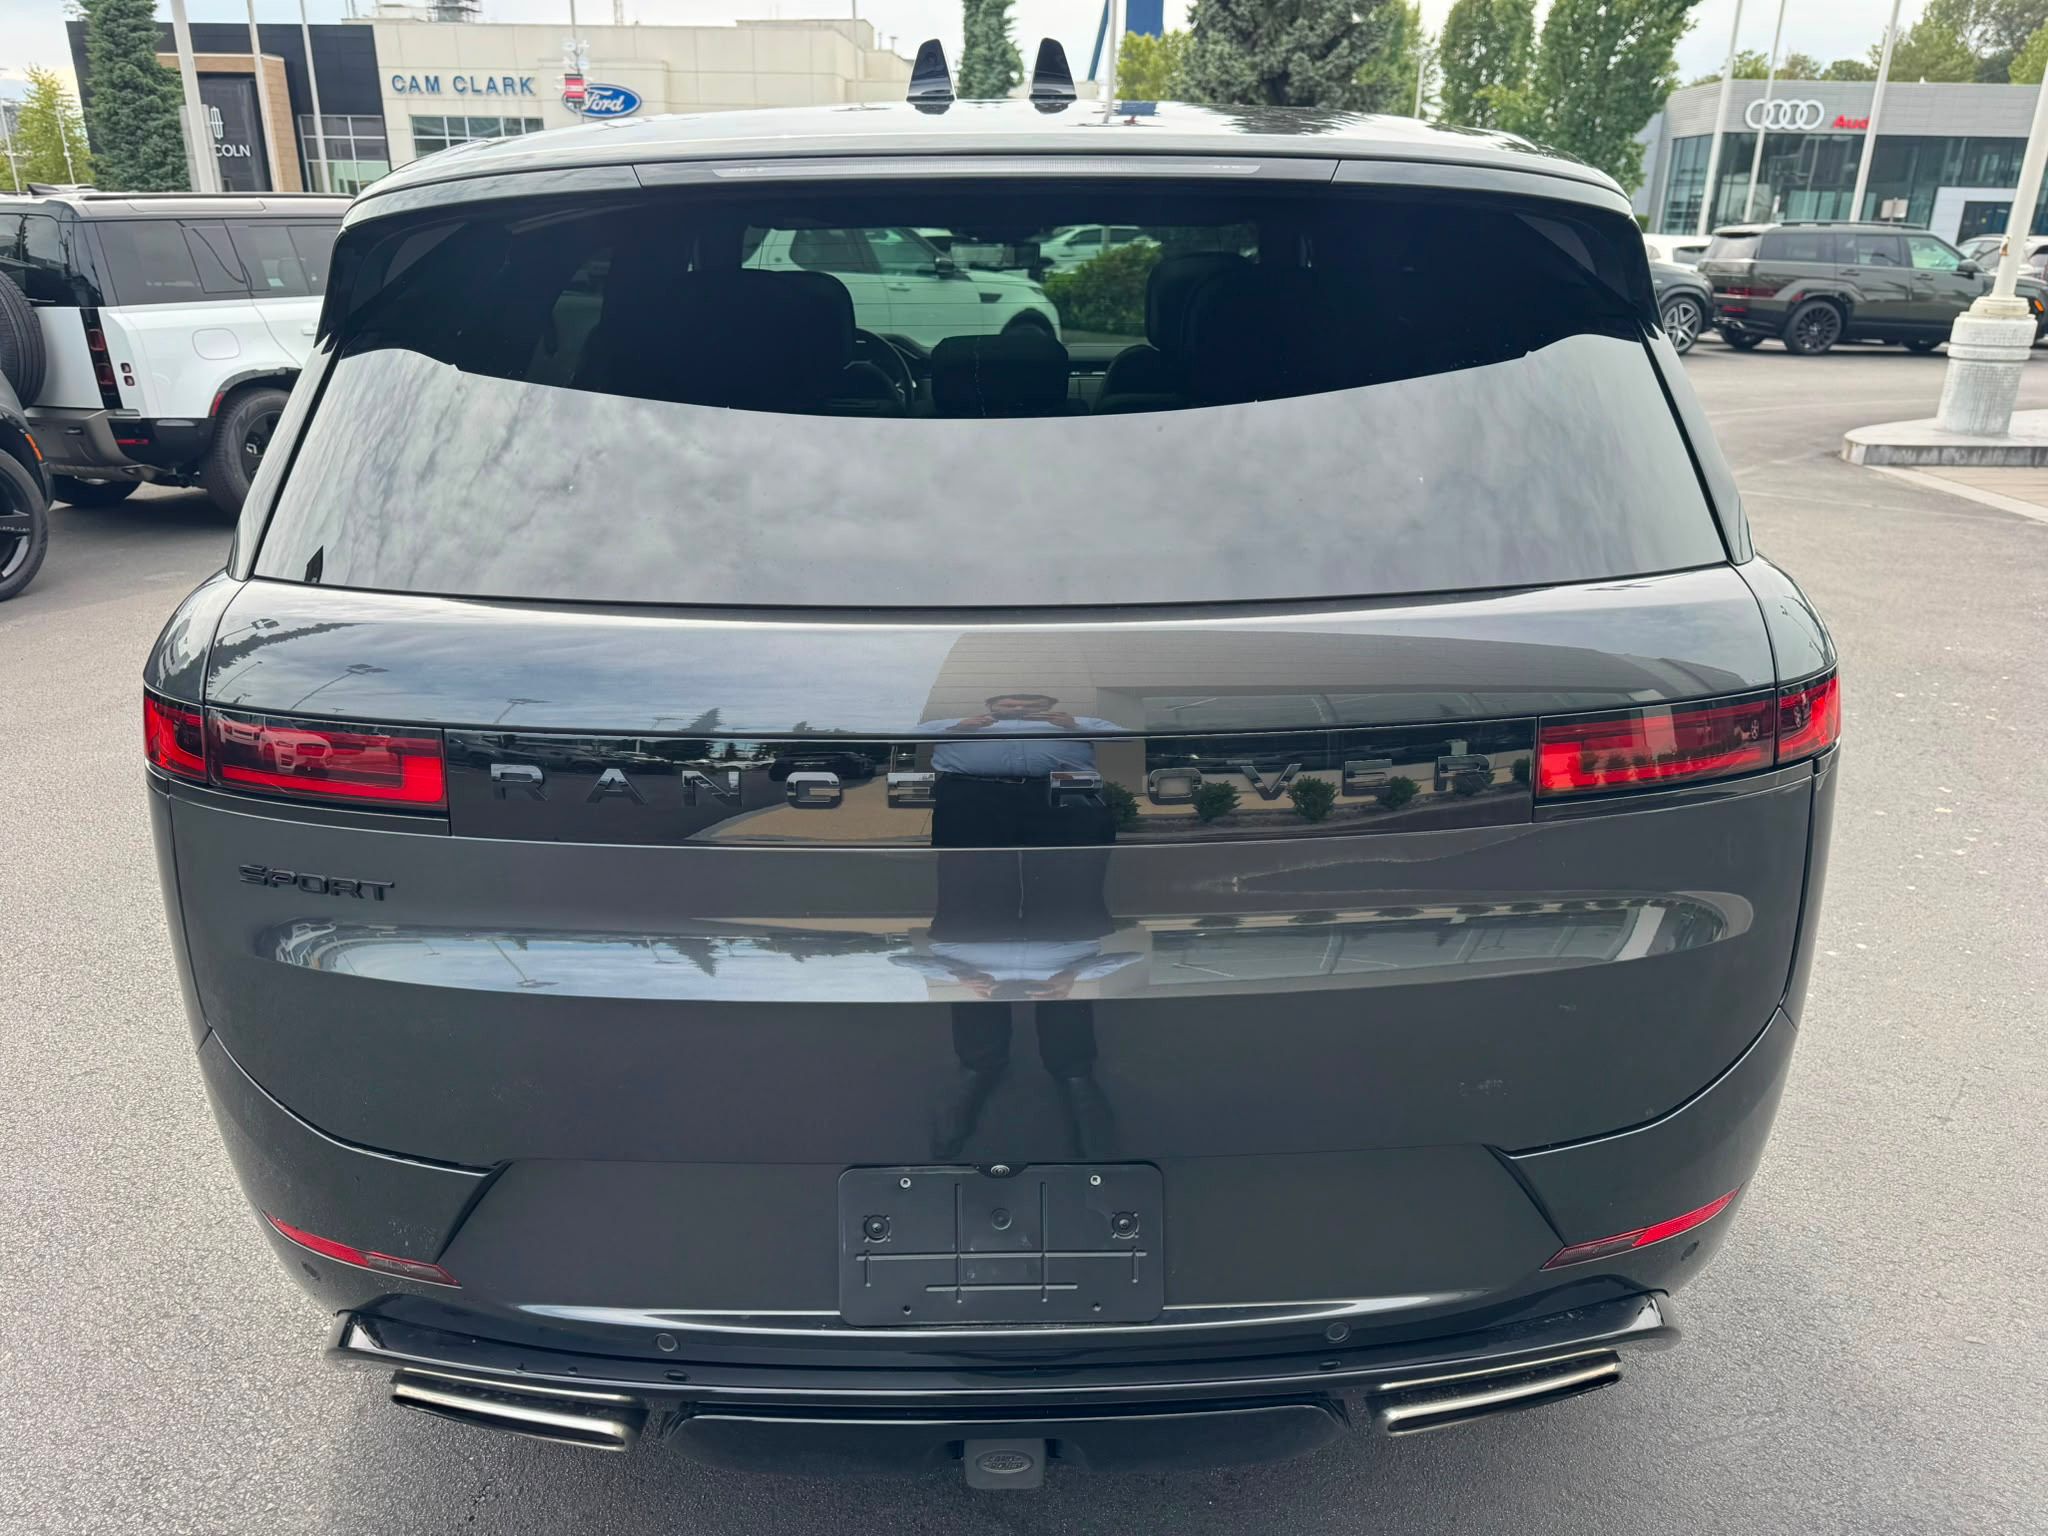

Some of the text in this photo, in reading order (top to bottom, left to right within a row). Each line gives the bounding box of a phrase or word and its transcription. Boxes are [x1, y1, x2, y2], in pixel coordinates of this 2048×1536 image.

[391, 75, 535, 95] CAM CLARK
[581, 88, 624, 112] Ford
[1832, 114, 1871, 129] Aud
[213, 144, 251, 157] COLN
[490, 753, 1496, 809] RANGE ROVER
[239, 863, 395, 902] SPORT
